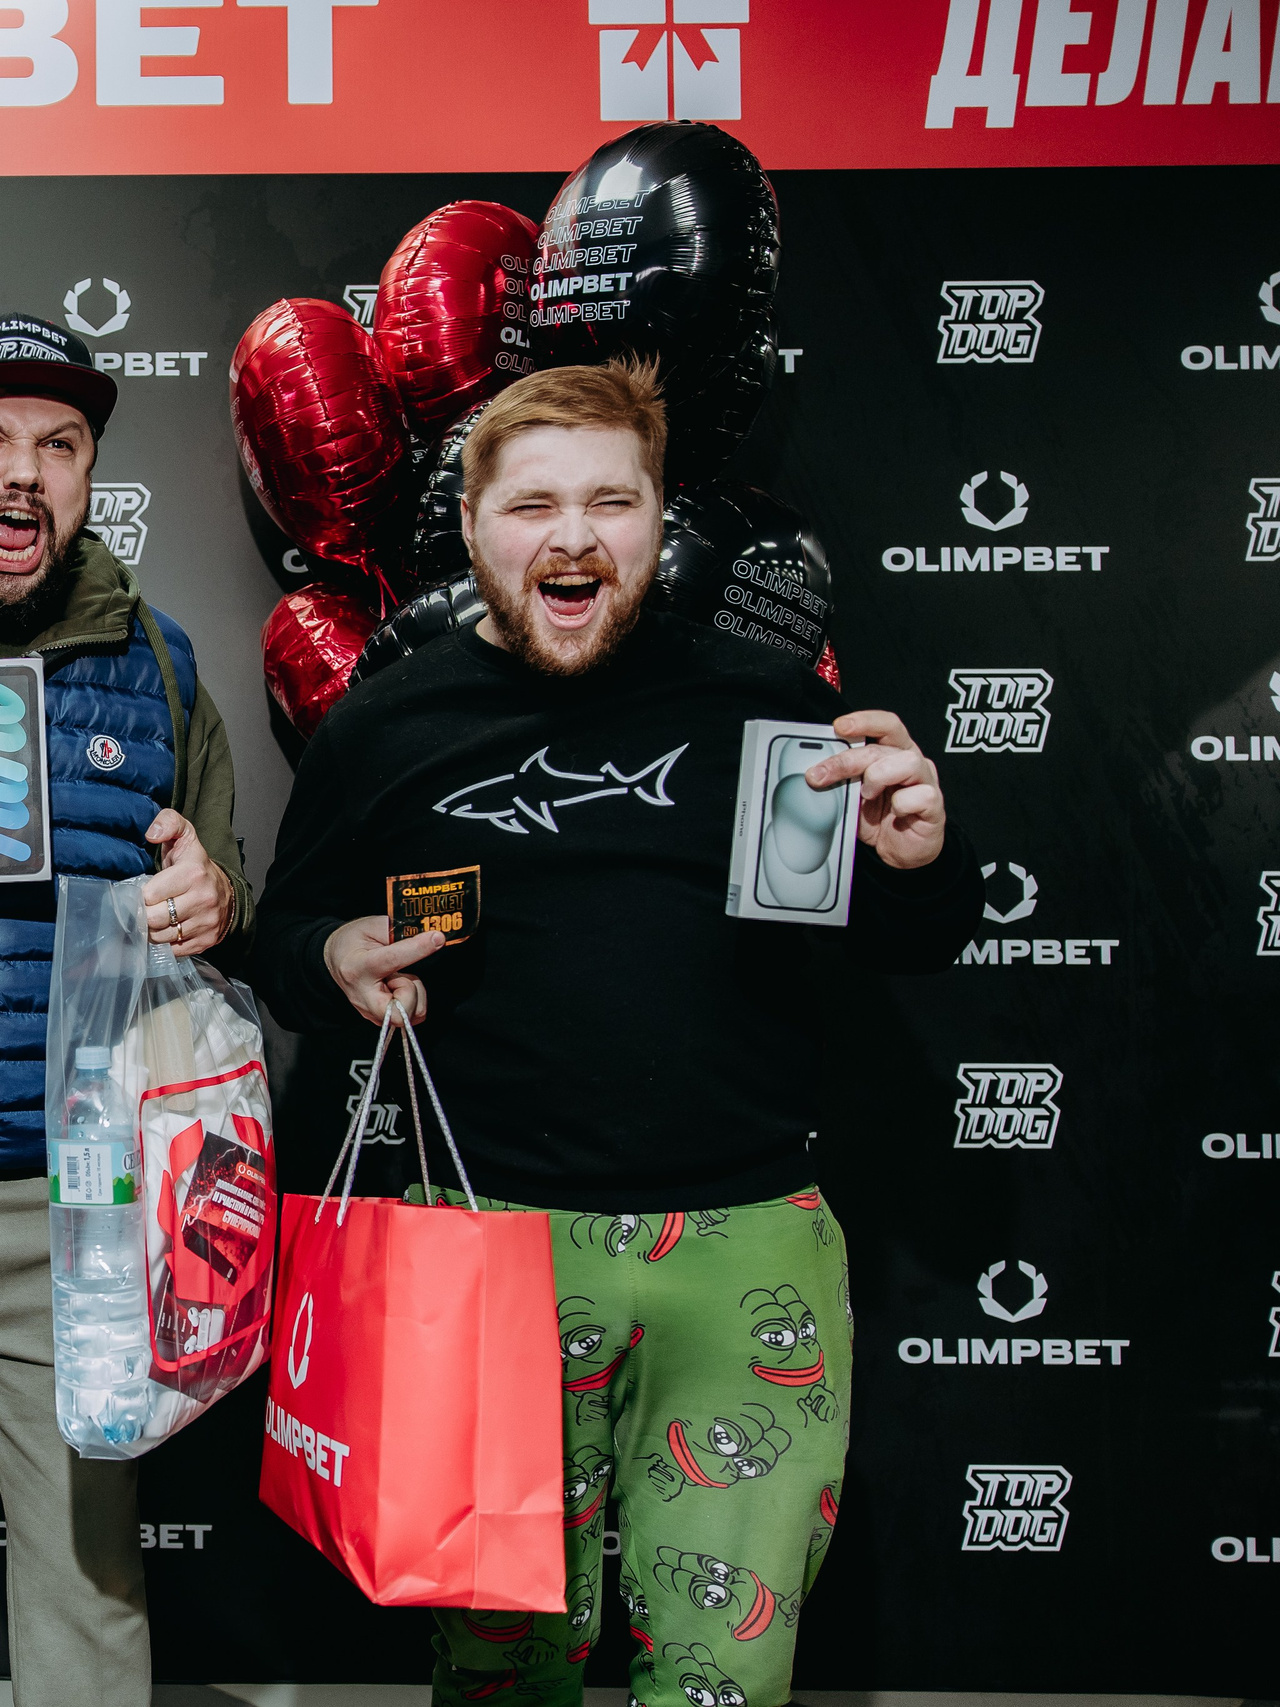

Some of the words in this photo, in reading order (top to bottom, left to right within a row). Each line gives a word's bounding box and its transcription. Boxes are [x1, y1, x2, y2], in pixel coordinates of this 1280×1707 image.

[545, 189, 651, 224] OLIMPBET
[537, 215, 643, 250] OLIMPBET
[532, 243, 637, 276] OLIMPBET
[530, 271, 633, 302] OLIMPBET
[529, 300, 631, 328] OLIMPBET
[949, 288, 1036, 321] TOP
[946, 322, 1032, 355] DOG
[93, 351, 209, 377] PBET
[880, 546, 1110, 572] OLIMPBET
[732, 559, 828, 619] OLIMPBET
[724, 584, 822, 644] OLIMPBET
[957, 676, 1045, 709] TOP
[954, 711, 1041, 745] DOG
[92, 750, 120, 766] MONCLER
[738, 800, 747, 837] iPhone
[401, 881, 465, 897] OLIMPBET
[402, 890, 466, 917] TICKET
[420, 911, 463, 933] 1306
[953, 938, 1120, 965] MPBET
[966, 1071, 1054, 1105] TOP
[963, 1107, 1051, 1140] DOG
[898, 1338, 1131, 1366] OLIMPBET
[265, 1396, 351, 1488] OLIMPBET
[975, 1472, 1064, 1506] TOP
[972, 1510, 1059, 1543] DOG
